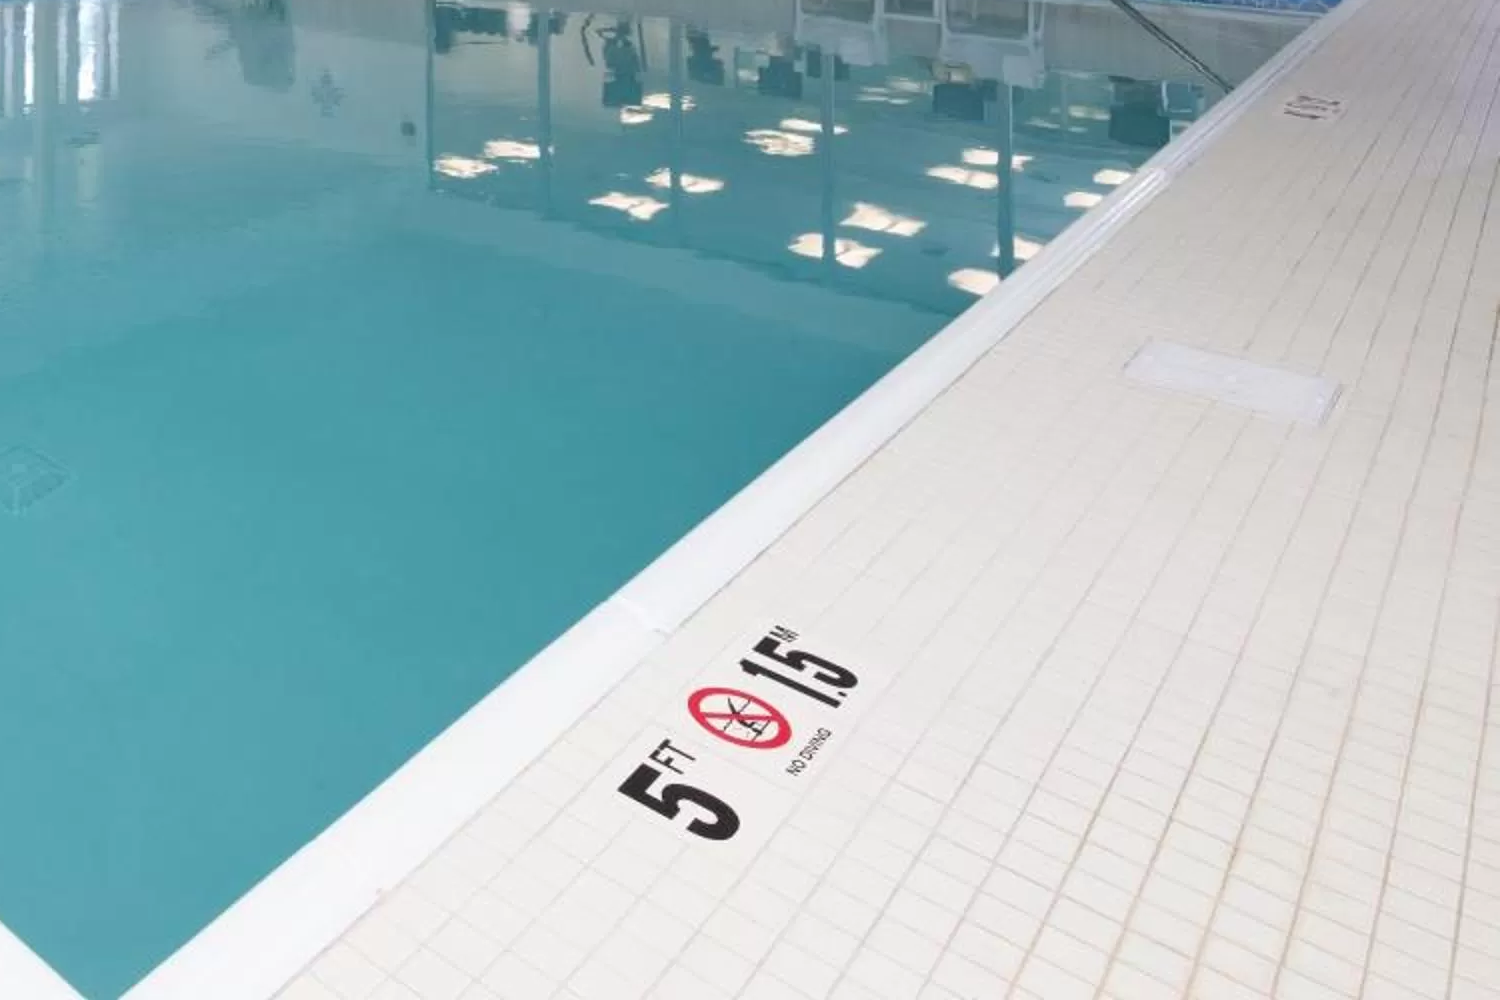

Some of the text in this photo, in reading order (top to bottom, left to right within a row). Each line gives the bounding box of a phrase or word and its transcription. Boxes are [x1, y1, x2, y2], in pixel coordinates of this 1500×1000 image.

[785, 727, 832, 777] NO DIVING
[617, 763, 740, 840] 5
